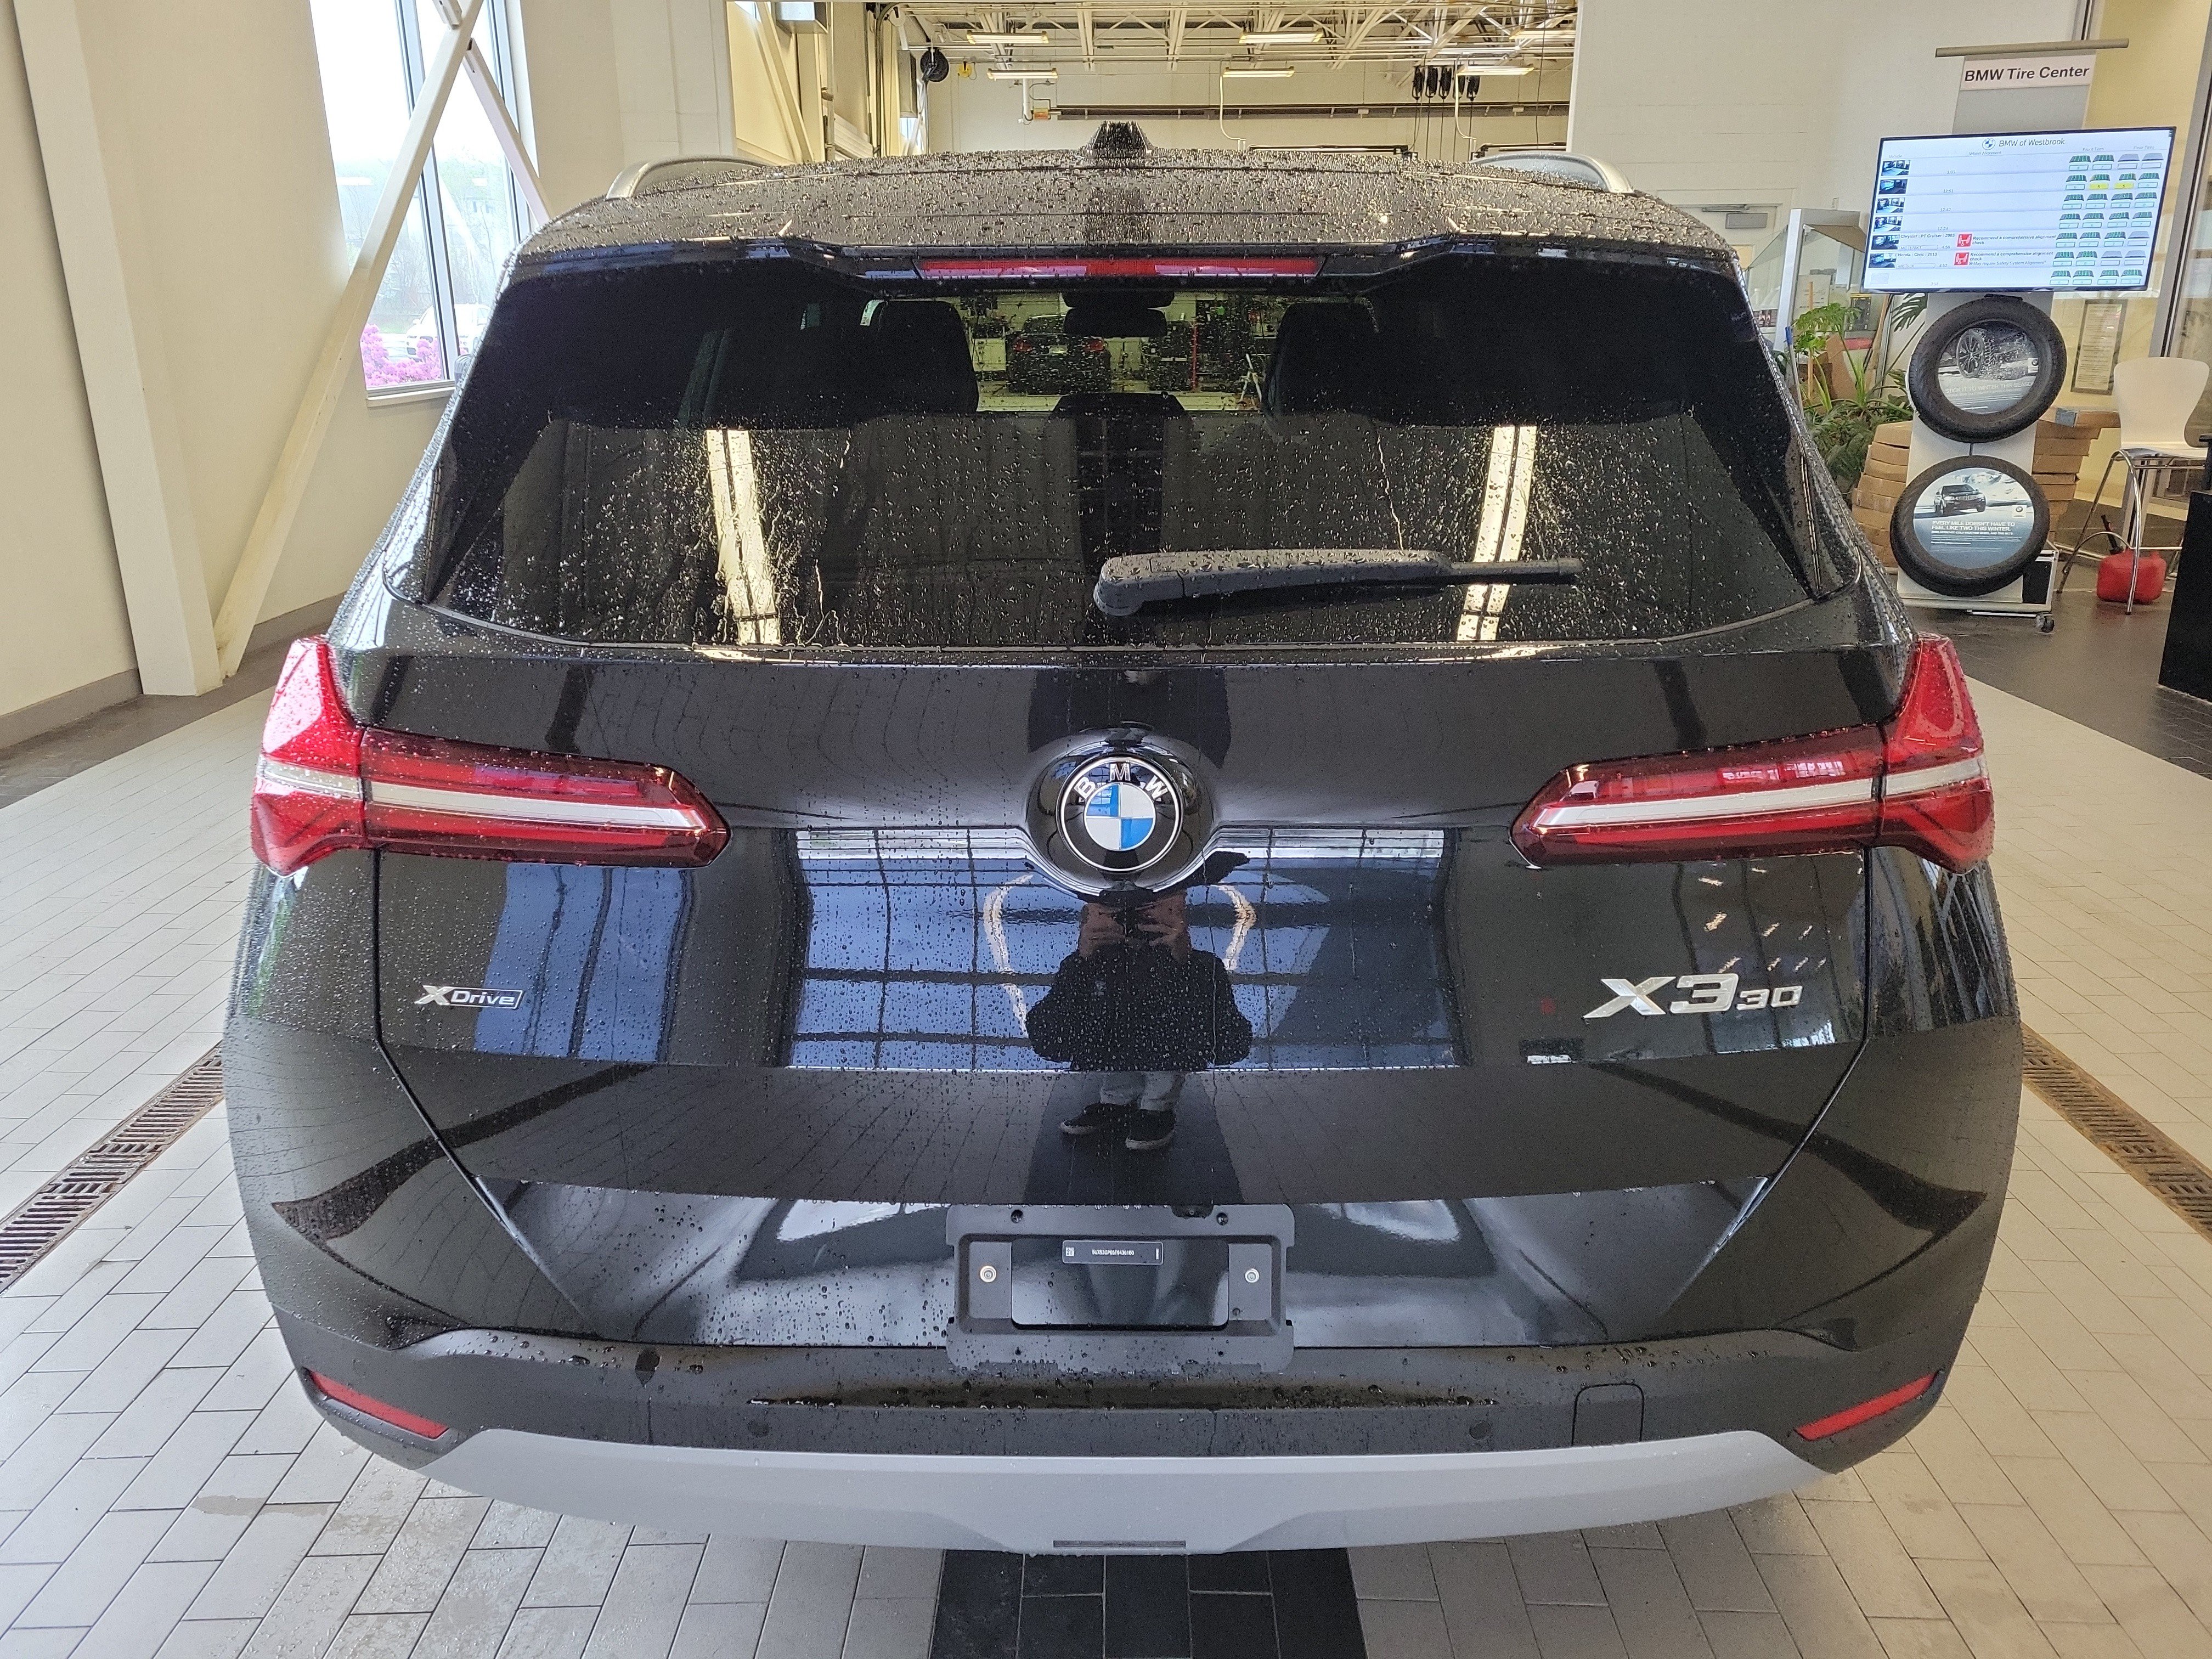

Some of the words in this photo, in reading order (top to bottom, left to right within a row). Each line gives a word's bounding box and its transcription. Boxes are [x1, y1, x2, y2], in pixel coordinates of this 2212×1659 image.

[1965, 69, 2004, 82] BMW
[2007, 67, 2035, 80] Tire
[2039, 66, 2090, 78] Center
[2028, 138, 2066, 146] Westbrook
[1074, 763, 1167, 800] BMW
